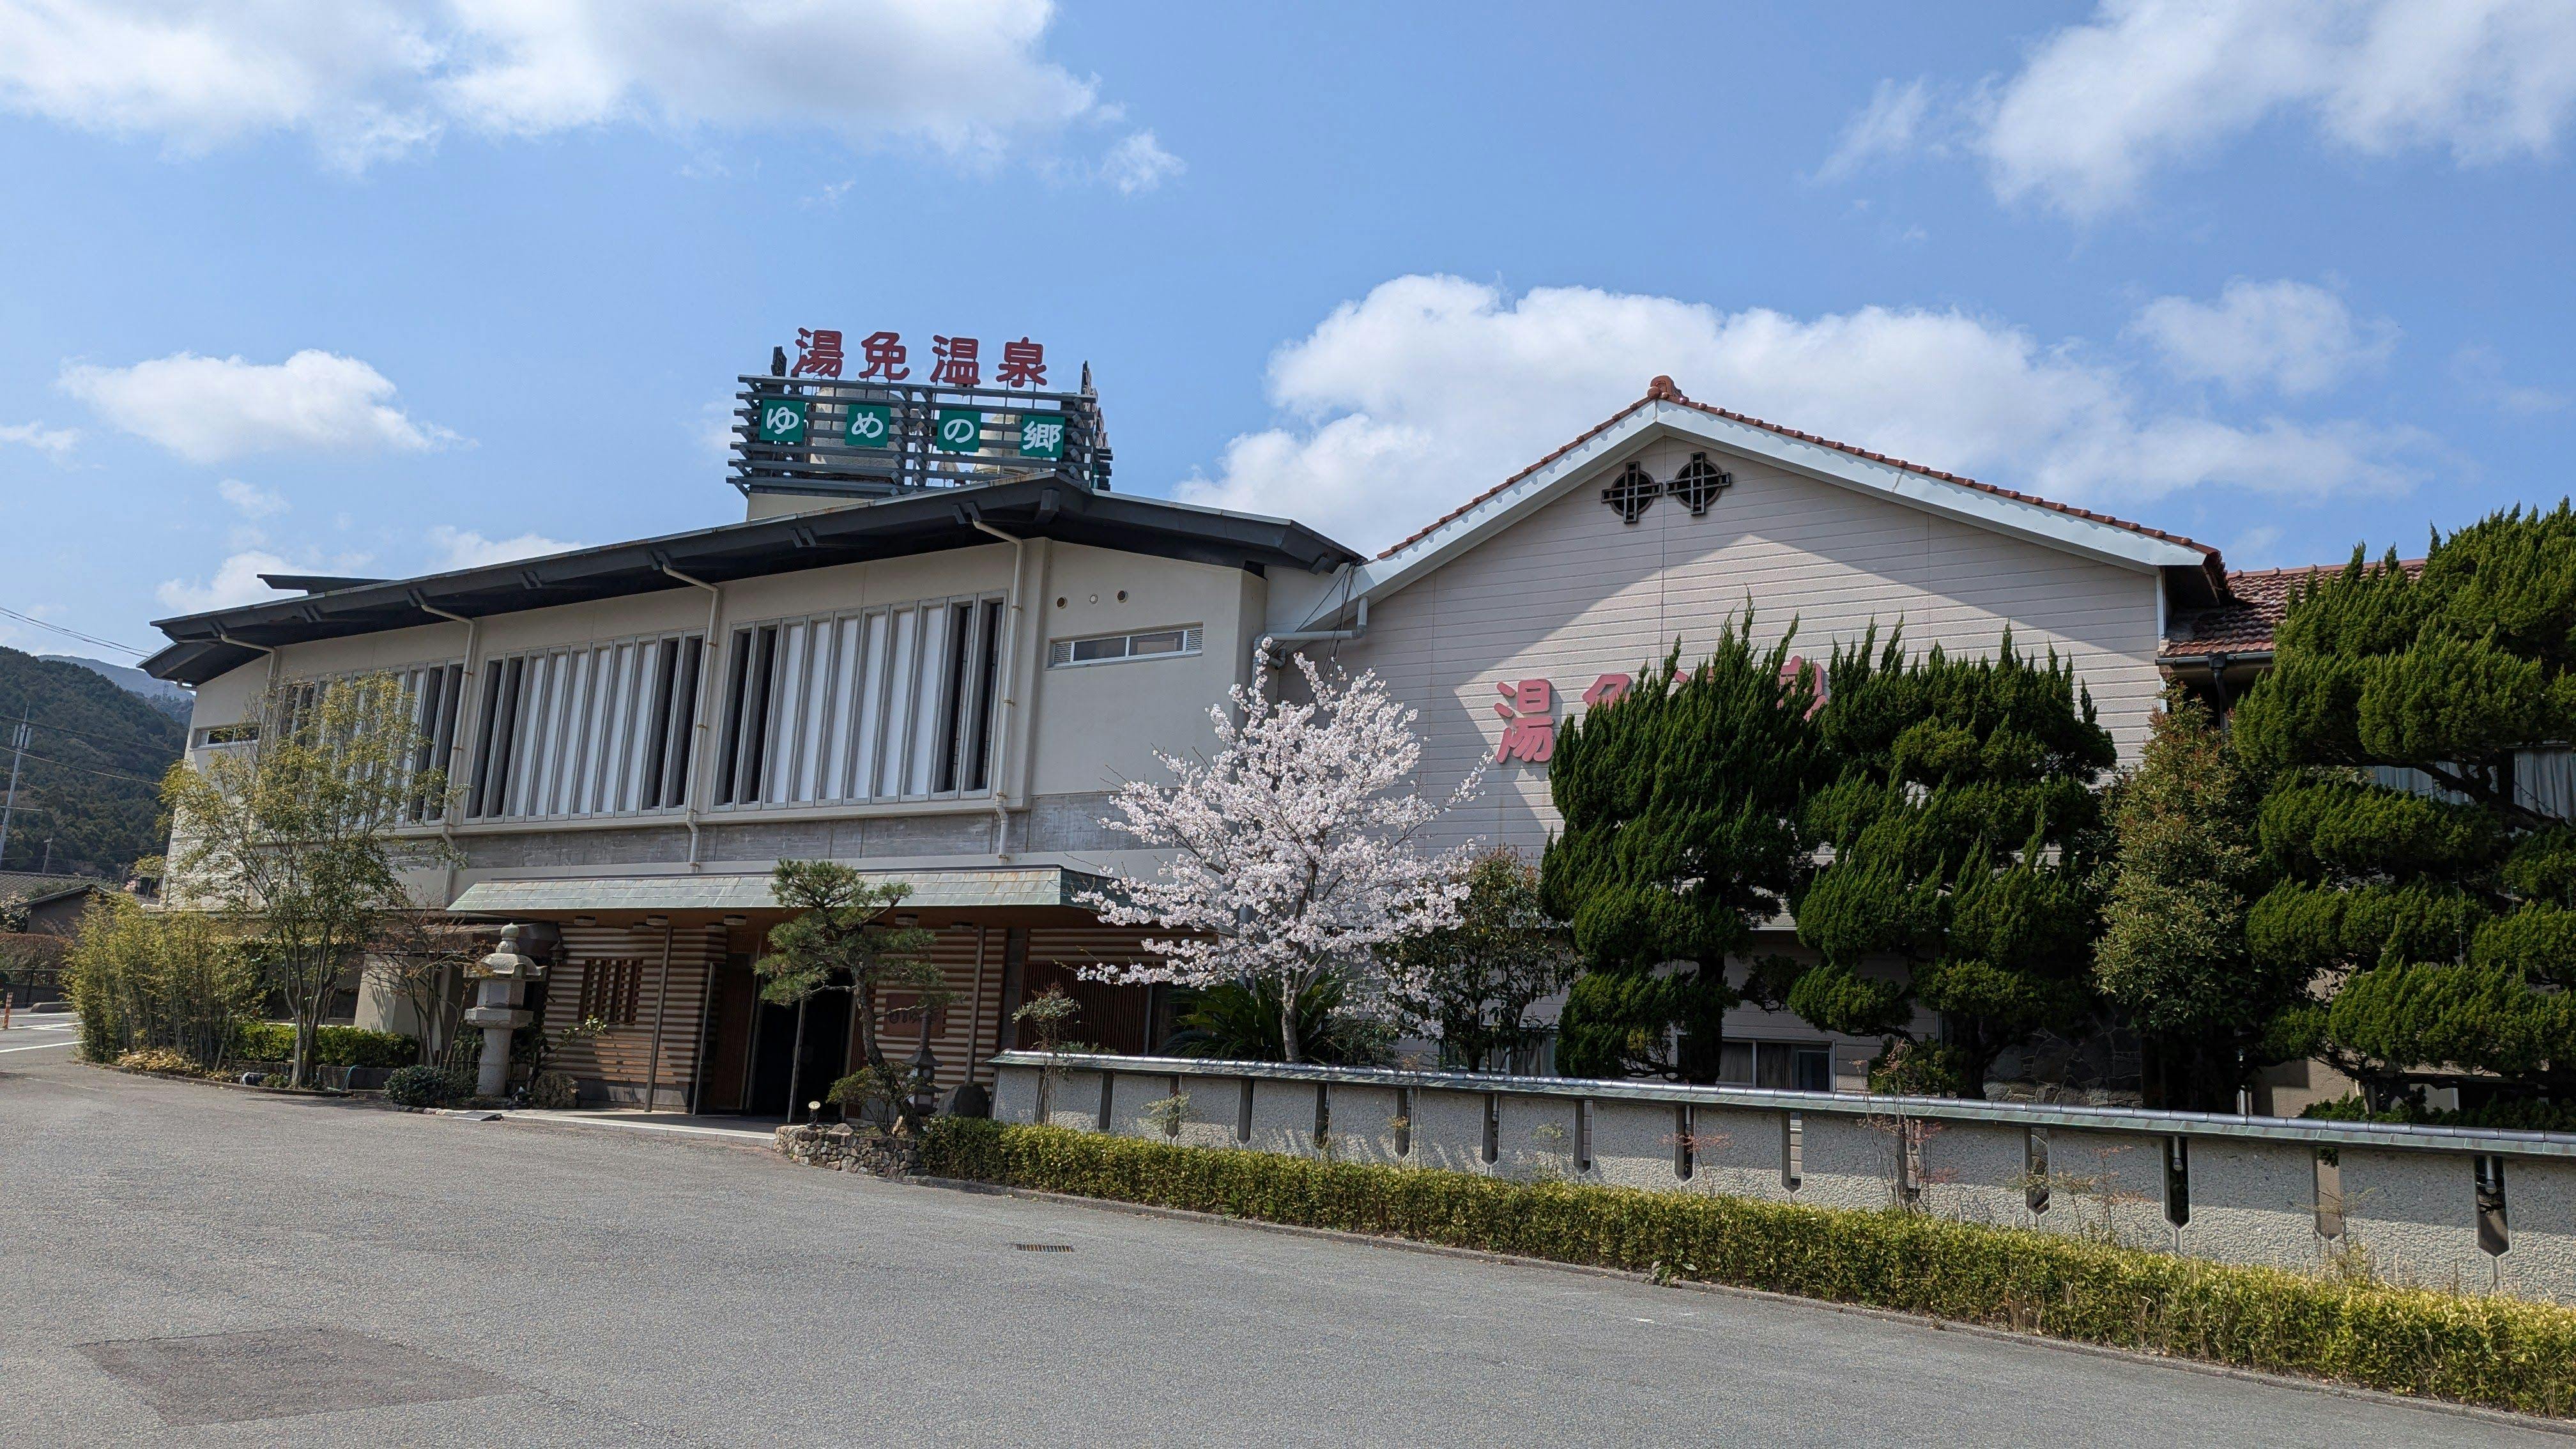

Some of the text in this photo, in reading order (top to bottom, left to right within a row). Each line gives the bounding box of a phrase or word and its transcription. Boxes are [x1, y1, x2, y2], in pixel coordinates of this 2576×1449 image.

[791, 327, 1048, 388] 湯免温泉
[766, 406, 1062, 452] ゆめの郷
